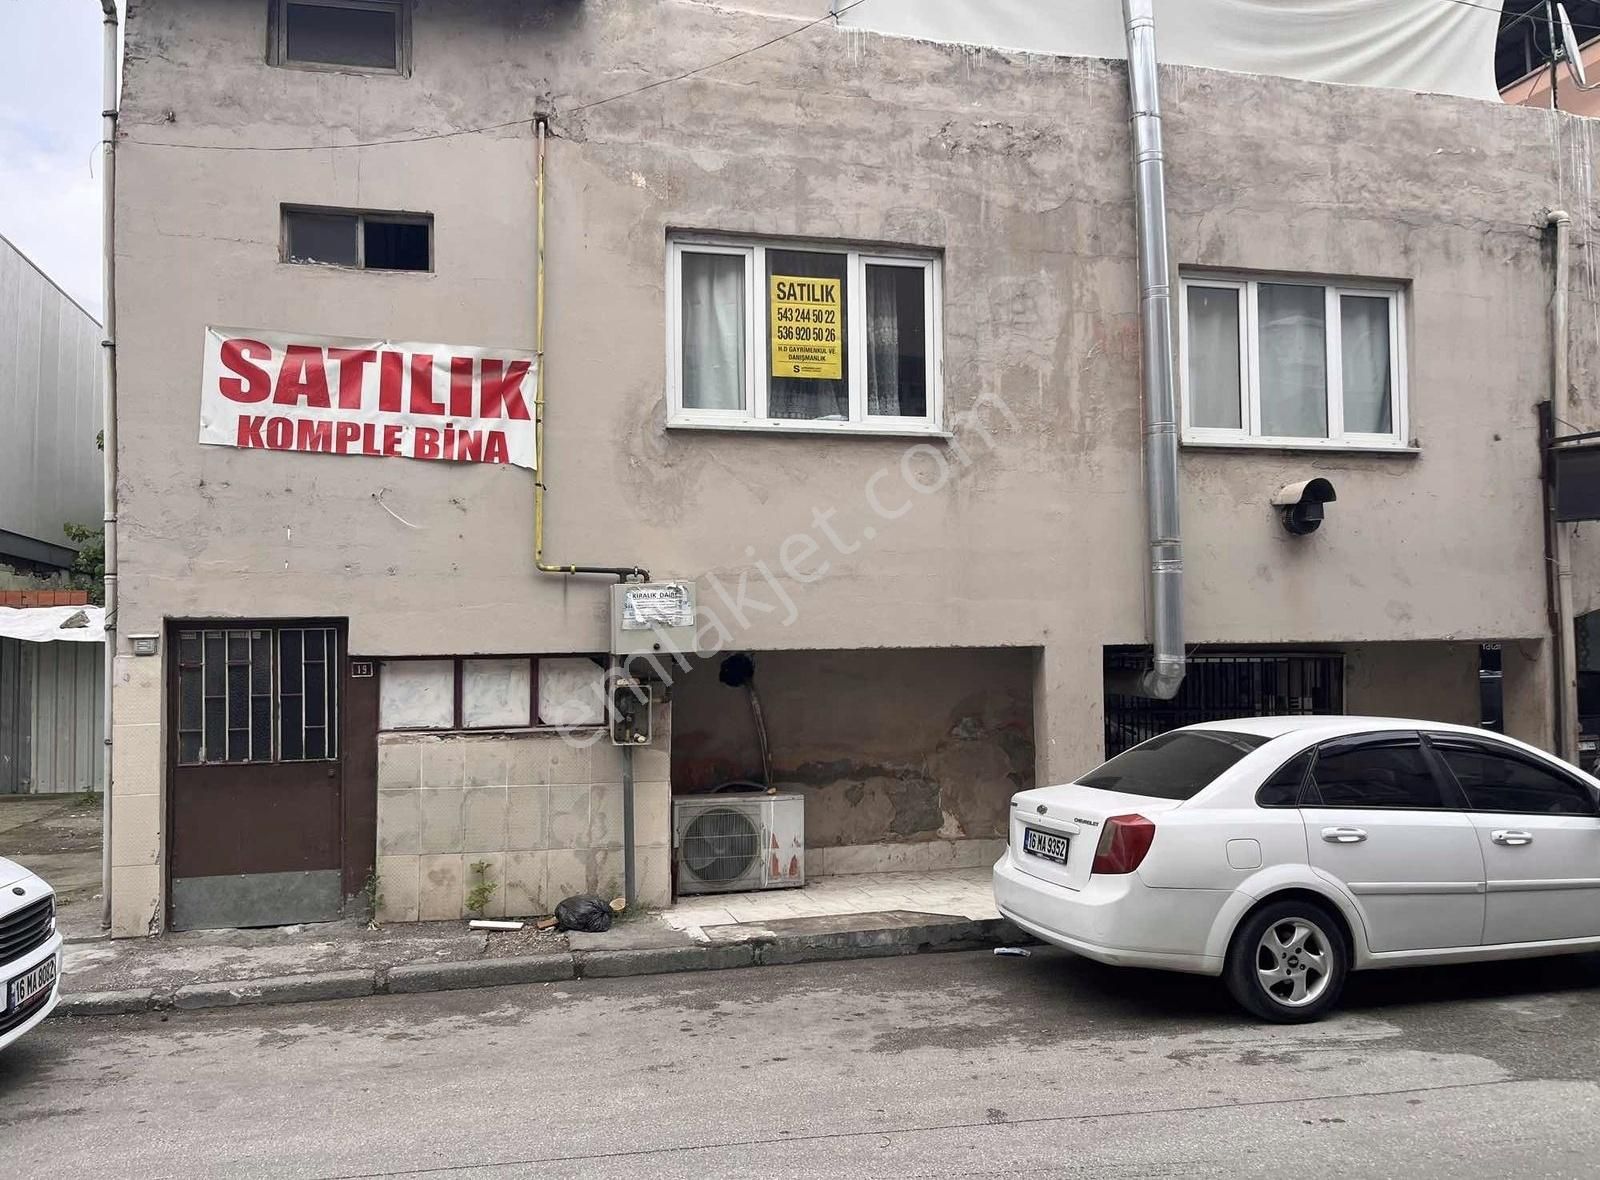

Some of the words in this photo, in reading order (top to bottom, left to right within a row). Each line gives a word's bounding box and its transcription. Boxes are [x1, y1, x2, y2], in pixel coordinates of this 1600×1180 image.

[776, 281, 836, 303] SATILIK
[777, 307, 794, 322] 543
[795, 308, 811, 323] 244
[812, 309, 823, 323] 50
[825, 310, 836, 324] 22
[777, 325, 794, 340] 536
[795, 326, 811, 341] 920
[812, 327, 823, 342] 50
[825, 328, 836, 342] 26
[219, 338, 532, 420] SATILIK
[236, 414, 403, 458] KOMPLE
[413, 422, 511, 464] BİNA
[1029, 831, 1037, 849] 16
[1037, 834, 1047, 851] MA
[1047, 837, 1066, 857] 9352
[16, 978, 25, 1002] 16
